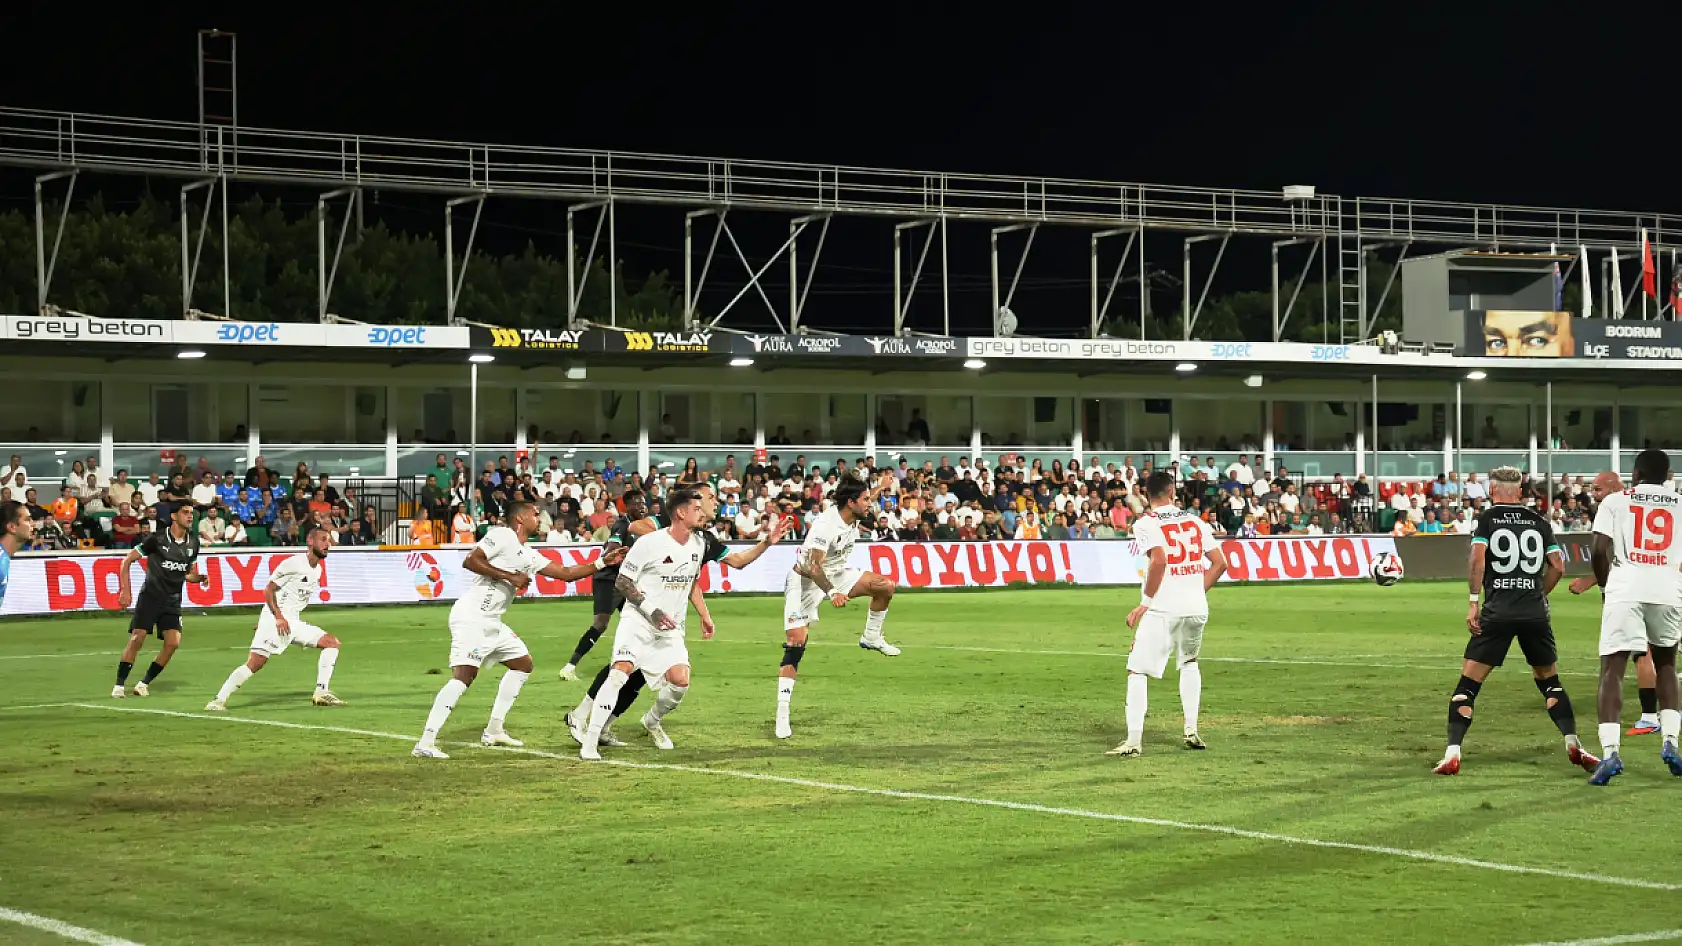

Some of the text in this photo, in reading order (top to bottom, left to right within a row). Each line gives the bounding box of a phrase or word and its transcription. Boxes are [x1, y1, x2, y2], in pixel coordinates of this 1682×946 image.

[16, 319, 164, 338] grey beton
[216, 323, 280, 343] opet
[367, 326, 426, 346] opet
[520, 329, 584, 342] TALAY
[1605, 325, 1662, 339] BODRUM
[653, 332, 713, 345] TALAY
[797, 337, 842, 348] ACROPOL
[763, 341, 794, 353] AURA
[883, 343, 912, 354] AURA
[973, 341, 1070, 355] grey beton
[1081, 342, 1176, 357] grey beton
[1583, 341, 1610, 359] İLÇE
[1631, 493, 1679, 504] REFORM
[1629, 504, 1674, 551] 19
[1160, 520, 1203, 565] 53
[1204, 537, 1375, 580] OYUYO!
[1489, 528, 1544, 575] 99
[868, 541, 1075, 588] DOYUYO!
